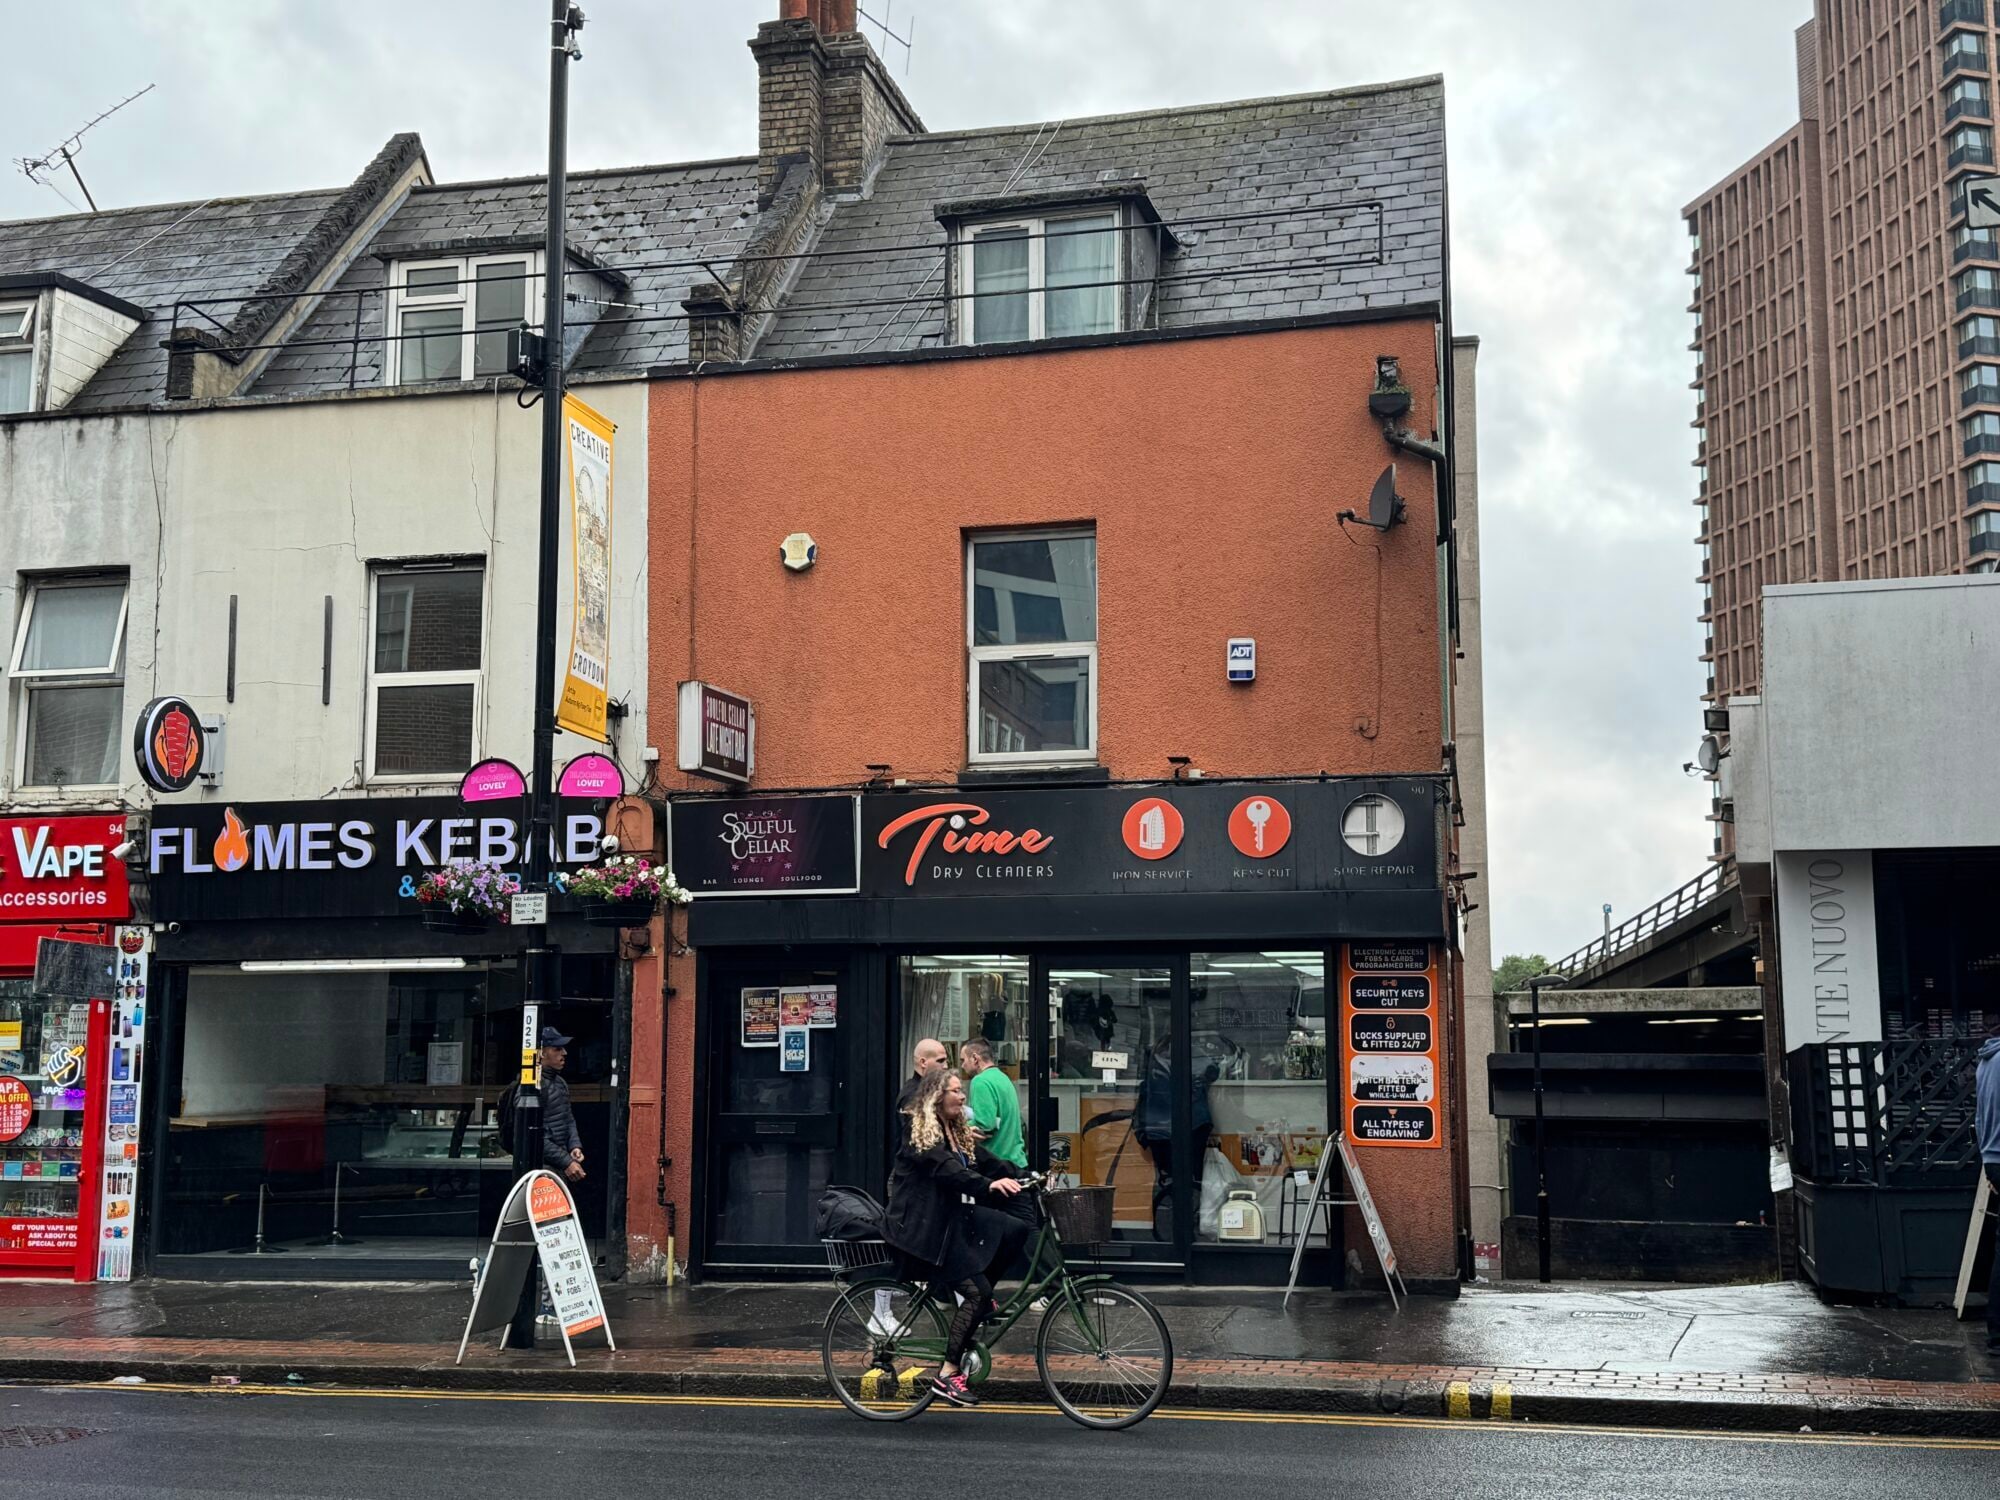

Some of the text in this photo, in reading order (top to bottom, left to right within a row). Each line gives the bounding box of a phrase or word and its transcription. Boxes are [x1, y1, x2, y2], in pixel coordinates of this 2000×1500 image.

[571, 423, 609, 464] CREATIVE
[1231, 646, 1252, 657] ADT
[573, 652, 604, 684] CROYDON
[479, 781, 507, 791] LOVELY
[577, 779, 605, 788] LOVELY
[109, 824, 123, 835] 94
[718, 813, 797, 844] SOULFUL
[731, 834, 793, 860] CELLAR
[878, 803, 1054, 886] Time
[12, 826, 104, 878] VAPE
[933, 865, 1054, 879] DRY CLEANERS
[1144, 870, 1193, 879] SERVICE
[1267, 868, 1291, 877] CUT
[1371, 865, 1415, 875] REPAIR
[1808, 859, 1848, 976] NUOVO
[1356, 989, 1425, 997] SECURITY KEYS
[1381, 998, 1399, 1006] CUT
[1355, 1032, 1426, 1040] LOCKS SUPPLIED
[1362, 1040, 1368, 1048] &
[1370, 1040, 1400, 1048] FITTED
[42, 1086, 65, 1096] VAPE
[65, 1089, 87, 1097] SHOP
[1378, 1085, 1406, 1093] FITTED
[8, 1093, 29, 1103] OFFER
[1362, 1120, 1424, 1129] ALL TYPES OF
[1367, 1129, 1420, 1138] ENGRAVING
[538, 1225, 561, 1237] YLINDER
[559, 1248, 581, 1260] MORTICE
[566, 1276, 577, 1285] KEY
[567, 1287, 581, 1296] FOBS
